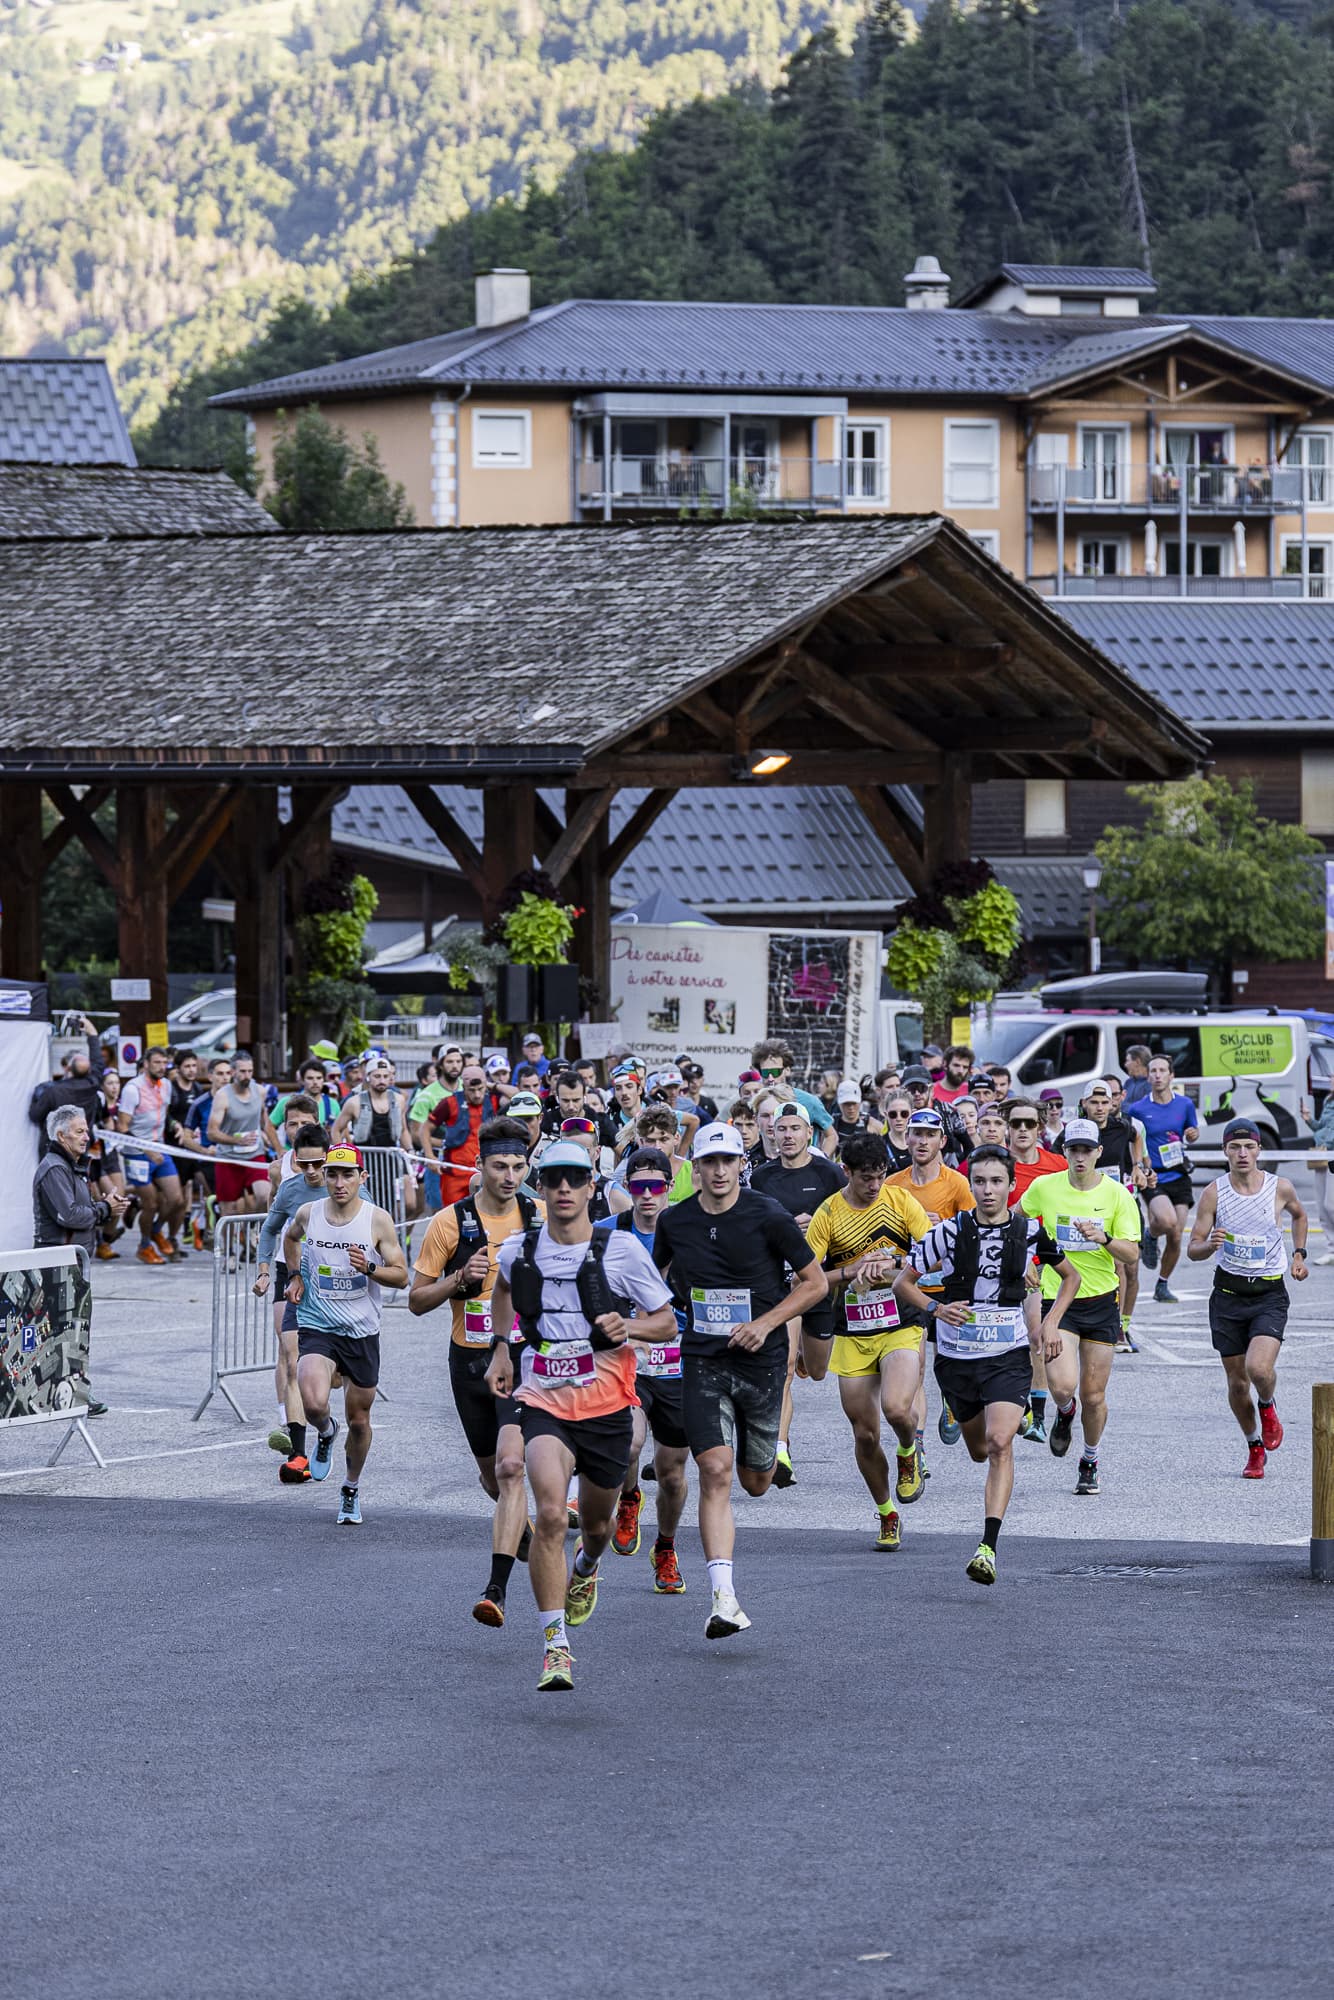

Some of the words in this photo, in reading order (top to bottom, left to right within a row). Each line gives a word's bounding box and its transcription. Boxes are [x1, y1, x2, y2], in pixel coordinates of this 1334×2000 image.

[610, 936, 642, 961] Des
[645, 946, 704, 962] cavistes
[641, 970, 676, 986] votre
[679, 975, 728, 989] service
[1242, 1033, 1274, 1046] CLUB
[316, 1240, 367, 1252] SCARA
[1234, 1246, 1252, 1259] 524
[332, 1278, 353, 1290] 508
[706, 1305, 732, 1322] 688
[857, 1303, 886, 1320] 1018
[975, 1326, 999, 1341] 704
[544, 1359, 580, 1376] 1023
